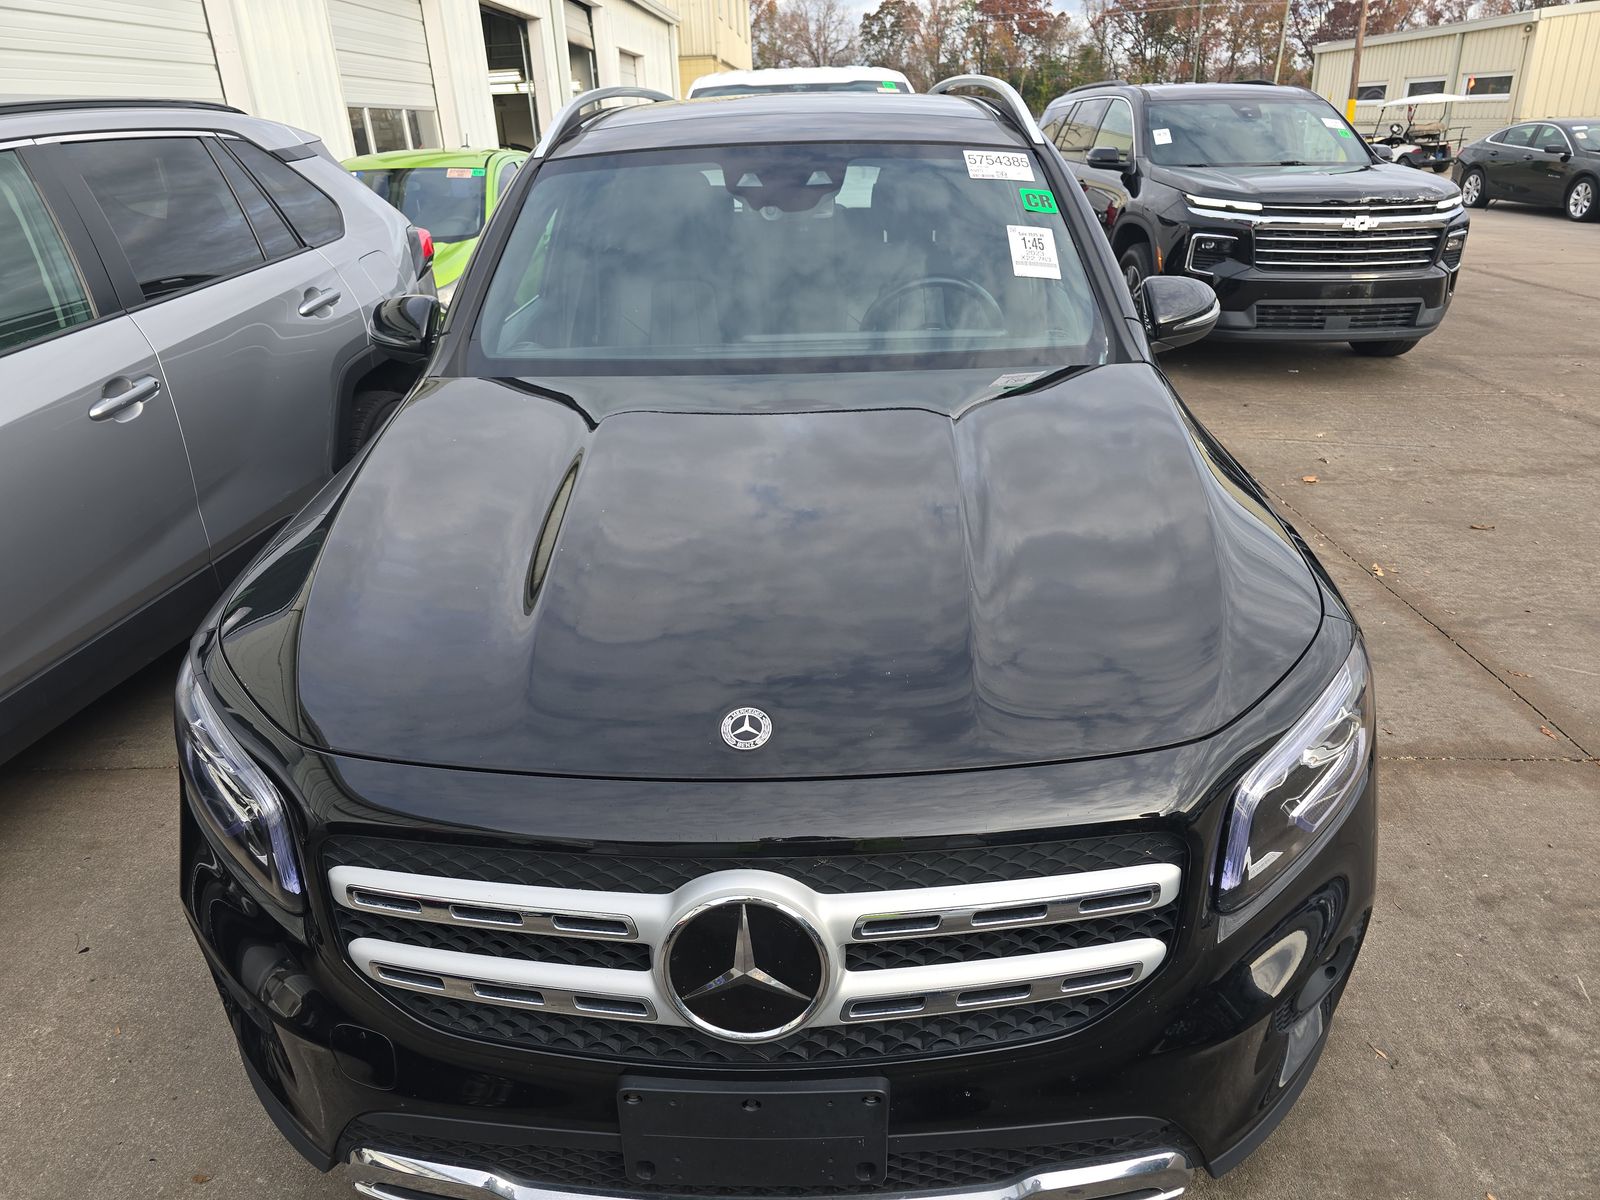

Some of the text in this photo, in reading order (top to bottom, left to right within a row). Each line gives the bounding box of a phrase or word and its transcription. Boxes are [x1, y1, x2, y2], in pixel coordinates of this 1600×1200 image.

[967, 154, 1029, 168] 5754385
[1025, 193, 1053, 209] CR
[1021, 236, 1045, 251] 1:45
